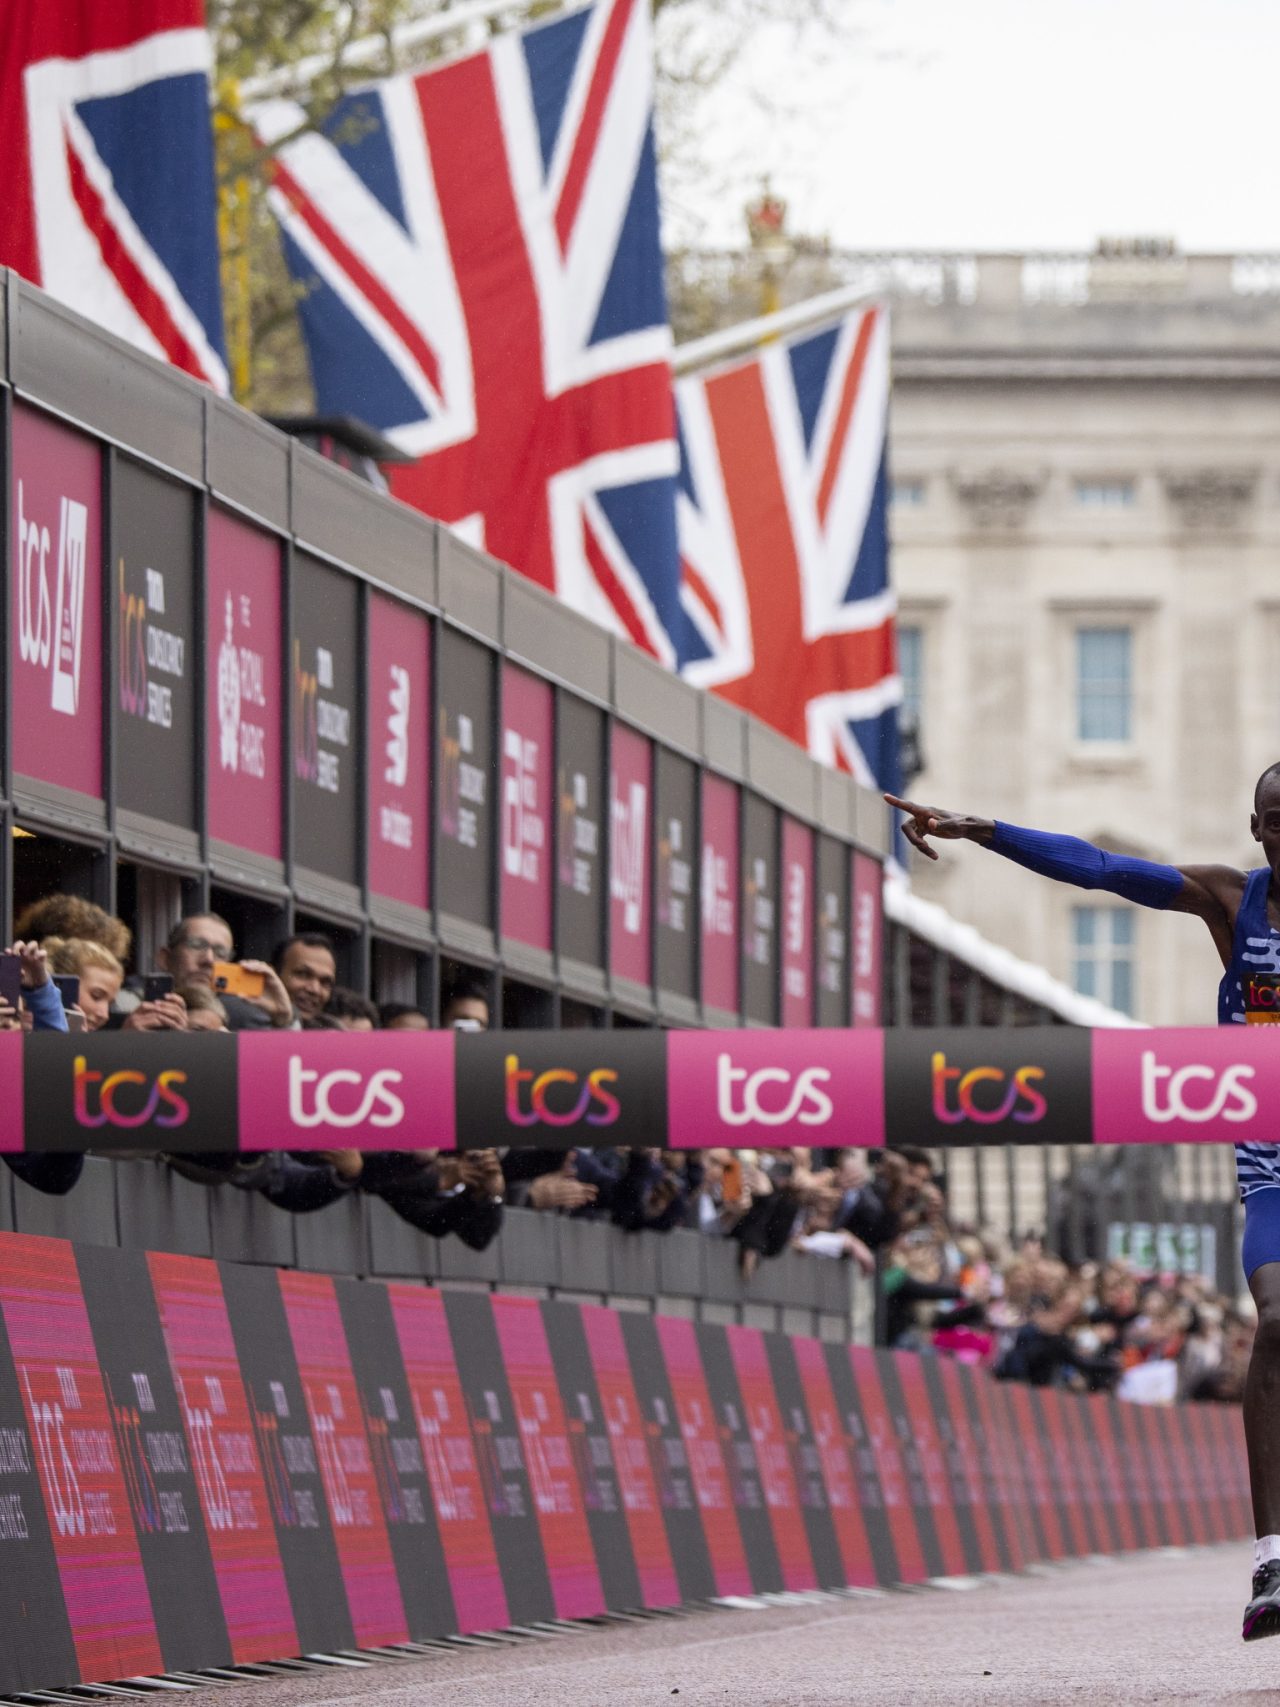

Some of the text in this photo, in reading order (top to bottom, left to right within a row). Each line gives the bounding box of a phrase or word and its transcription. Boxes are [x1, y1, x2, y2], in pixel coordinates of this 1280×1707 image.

[18, 477, 51, 669] tcs
[73, 1055, 190, 1128] tcs
[288, 1054, 405, 1128] tcs
[503, 1054, 621, 1126] tcs
[716, 1051, 833, 1126] tcs
[930, 1051, 1048, 1124] tcs
[1140, 1049, 1258, 1123] tcs
